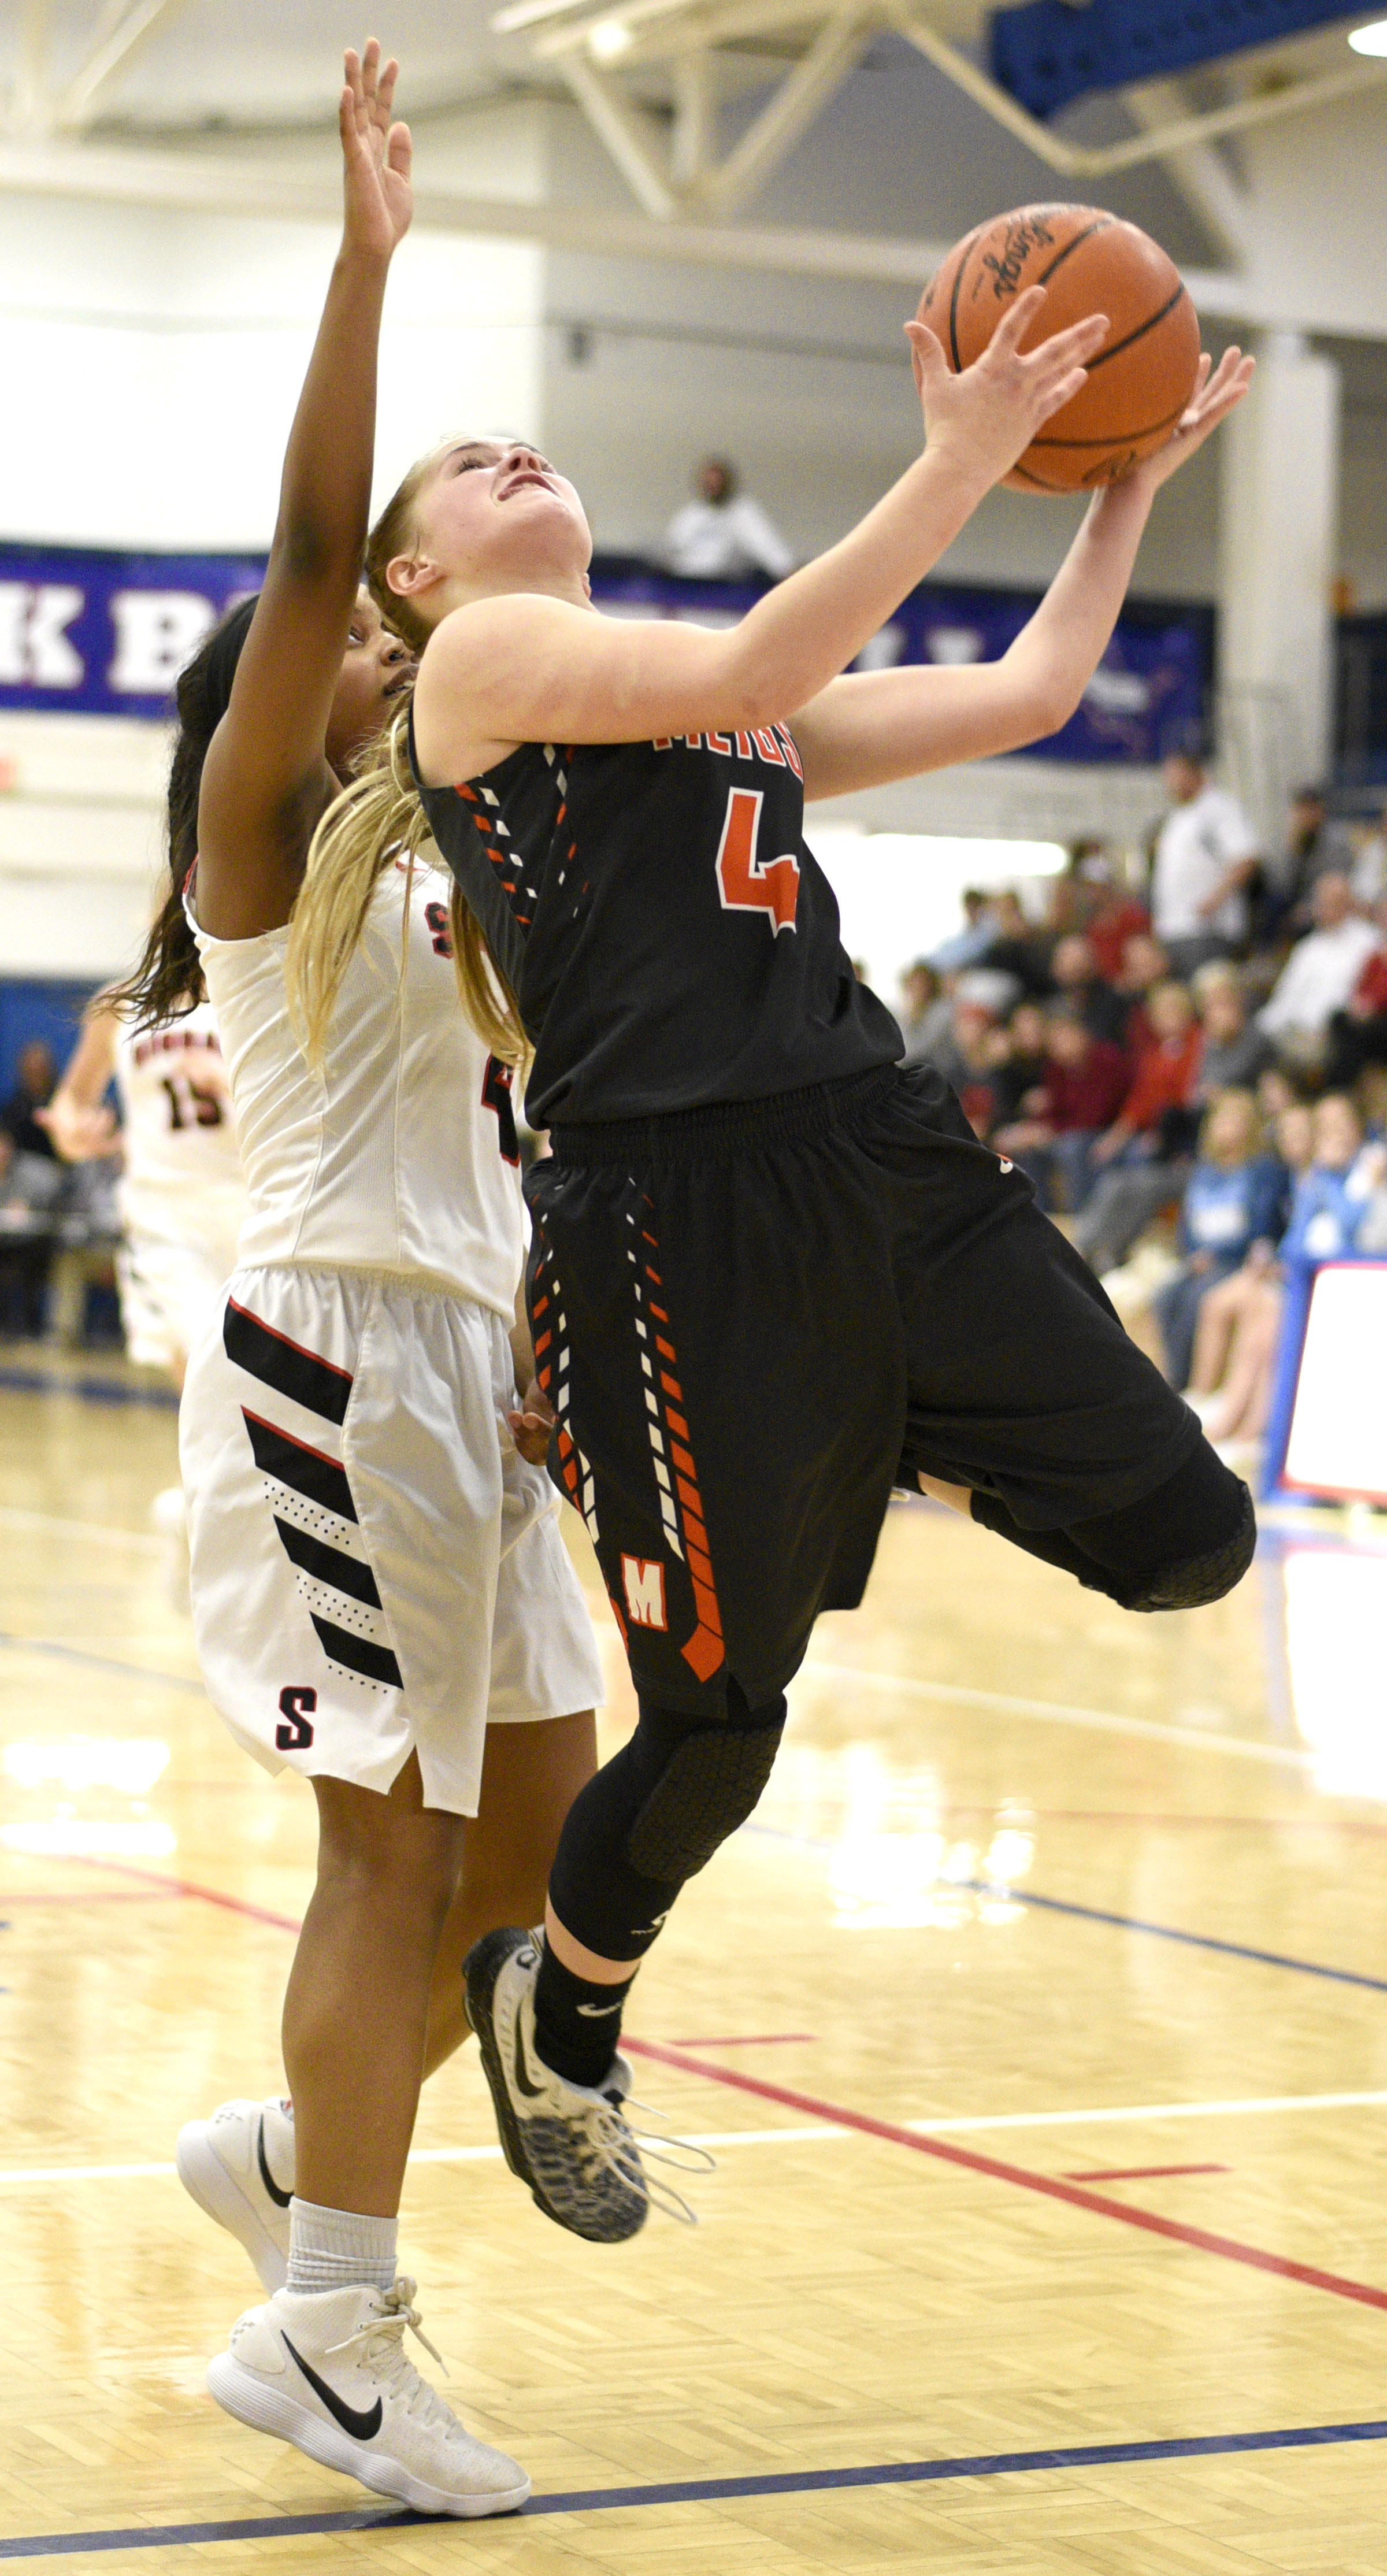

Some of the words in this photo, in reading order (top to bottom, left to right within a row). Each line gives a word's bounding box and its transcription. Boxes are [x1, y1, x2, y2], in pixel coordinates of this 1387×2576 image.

[715, 786, 800, 939] 4
[620, 1552, 668, 1633] M
[276, 1685, 317, 1751] S
